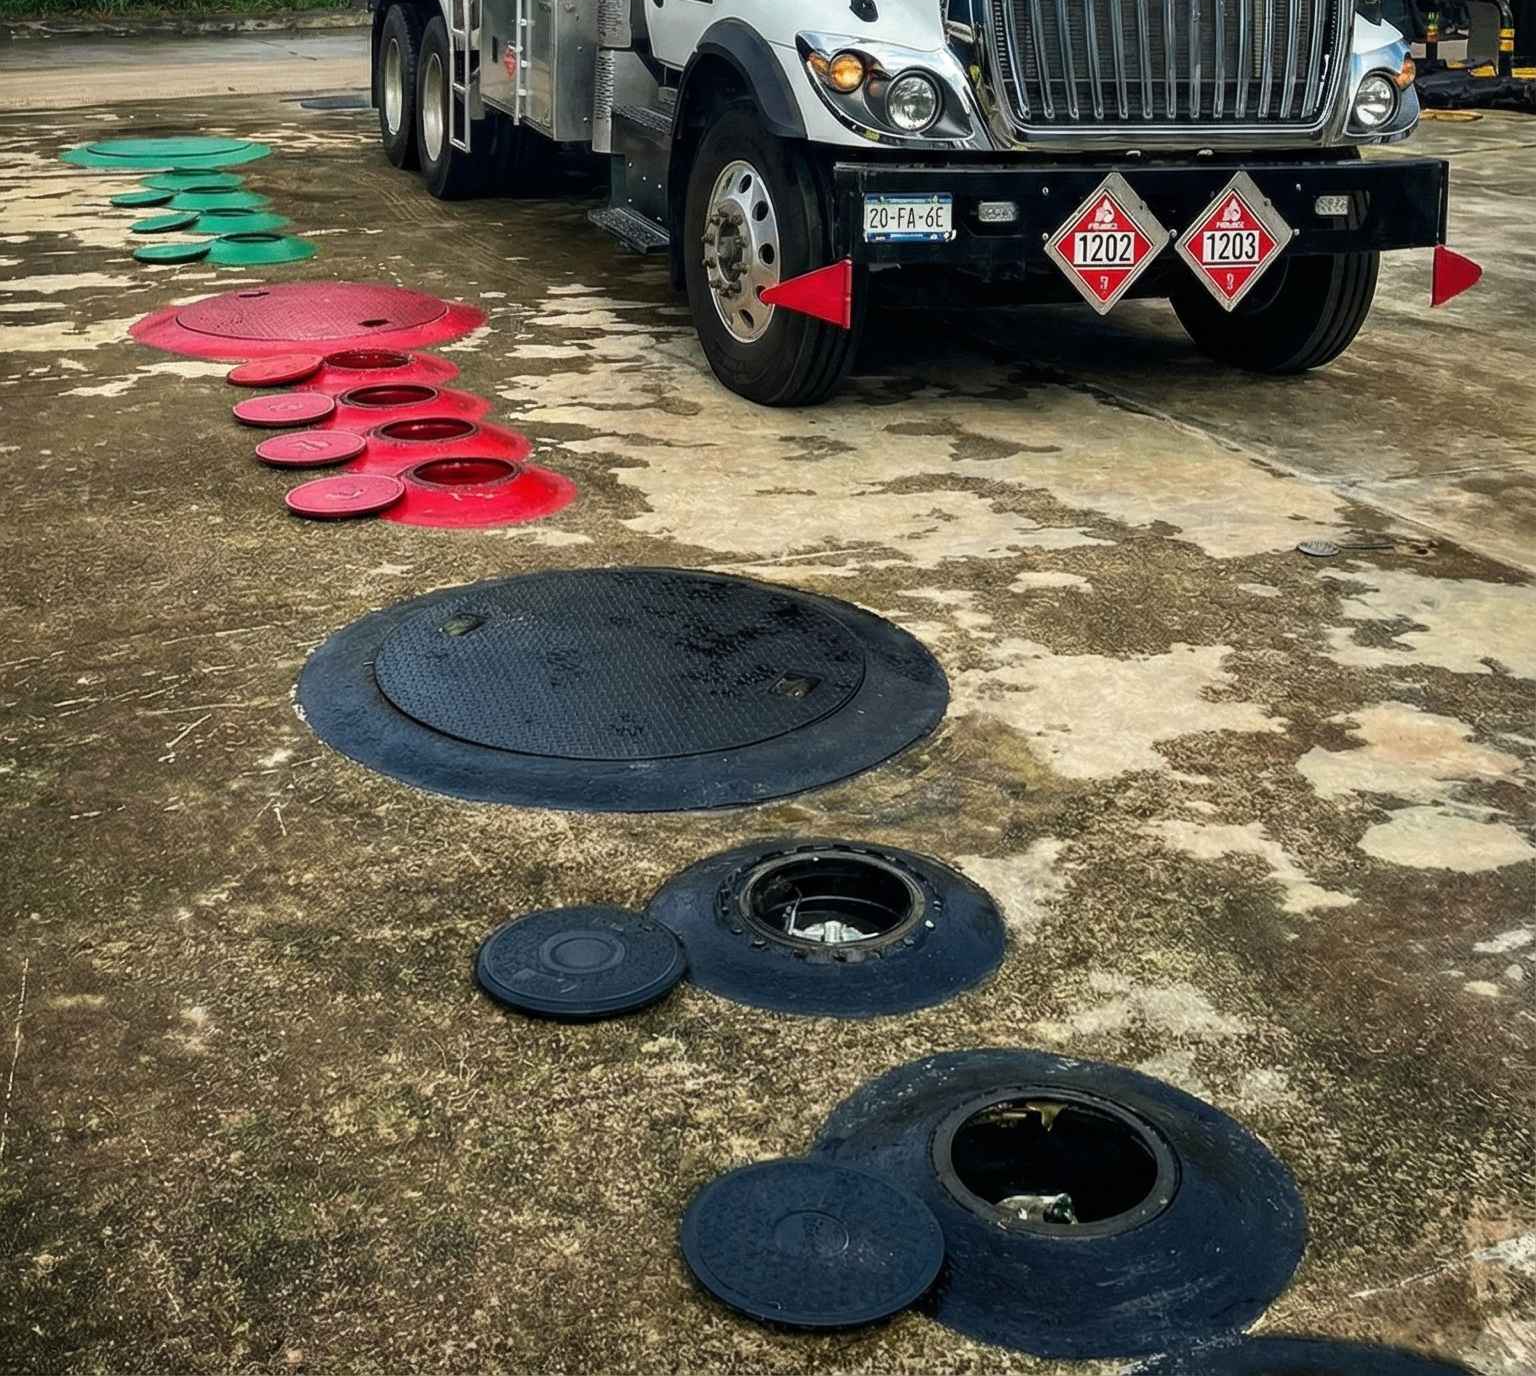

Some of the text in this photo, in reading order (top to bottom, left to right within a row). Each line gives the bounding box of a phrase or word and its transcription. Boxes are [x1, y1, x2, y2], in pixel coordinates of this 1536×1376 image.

[869, 207, 944, 229] 20-FA-6E
[1079, 233, 1132, 262] 1202
[1206, 232, 1257, 260] 1203
